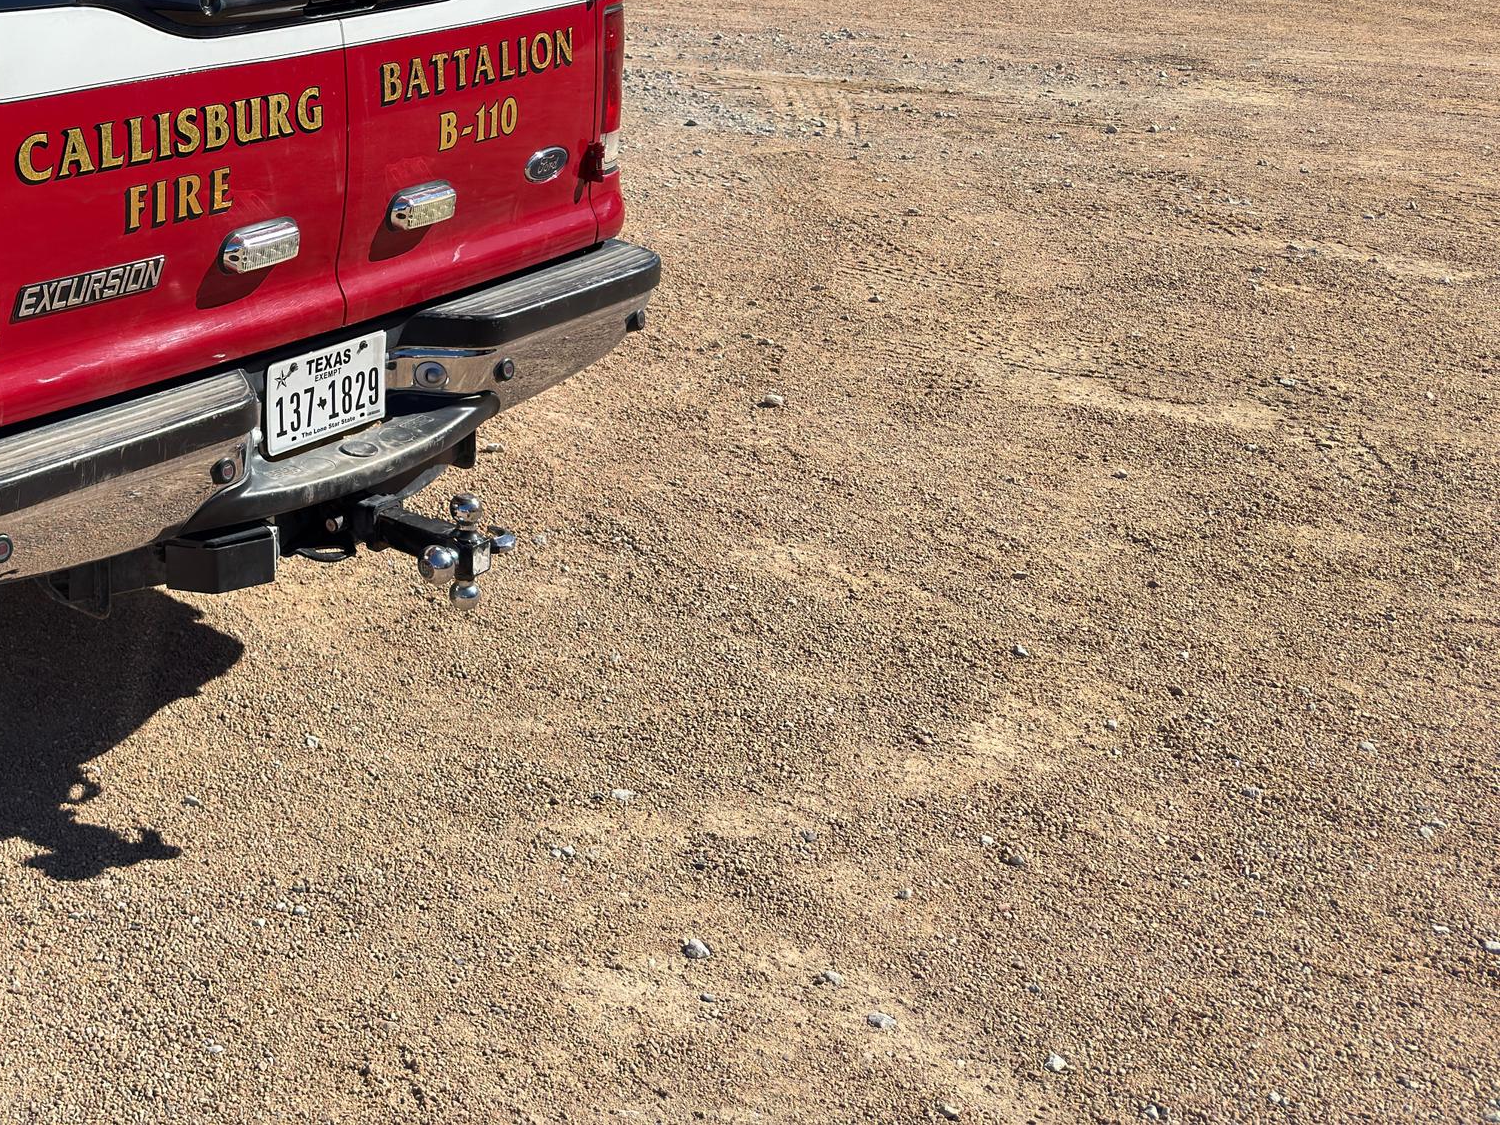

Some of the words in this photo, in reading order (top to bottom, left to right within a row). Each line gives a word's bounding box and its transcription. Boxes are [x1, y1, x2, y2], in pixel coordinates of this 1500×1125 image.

[379, 27, 573, 107] BATTALION
[15, 86, 324, 185] CALLISBURG
[438, 96, 519, 152] B-110
[124, 166, 234, 235] FIRE
[17, 258, 165, 318] EXCURSION
[306, 348, 351, 375] TEXAS
[314, 368, 342, 382] EXEMPT
[302, 430, 312, 439] The
[314, 426, 327, 434] Lone
[328, 421, 340, 429] Star
[341, 416, 356, 425] State
